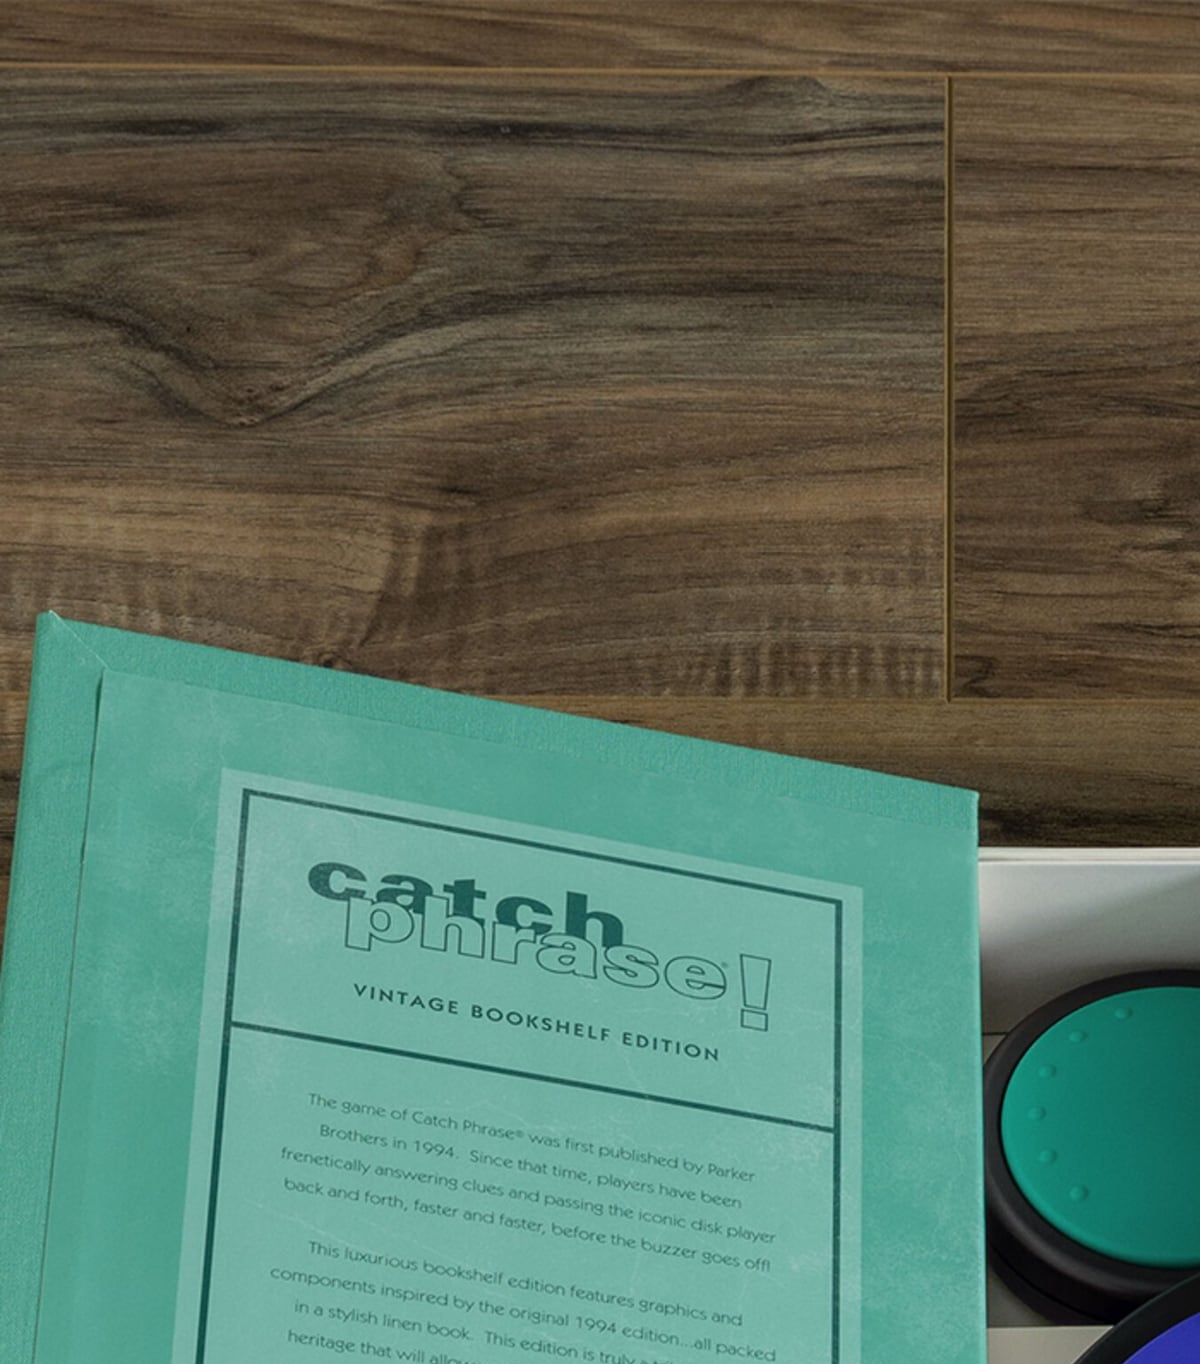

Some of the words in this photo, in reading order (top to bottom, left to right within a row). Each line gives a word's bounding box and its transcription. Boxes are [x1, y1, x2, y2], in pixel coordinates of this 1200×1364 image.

[308, 861, 625, 948] catch
[344, 894, 772, 1032] phrase!
[353, 982, 458, 1015] VINTAGE
[470, 1003, 610, 1041] BOOKSHELF
[621, 1031, 718, 1061] EDITION
[308, 1092, 337, 1110] The
[340, 1100, 386, 1117] game
[389, 1107, 408, 1121] of
[410, 1110, 458, 1130] Catch
[527, 1133, 561, 1148] was
[564, 1136, 594, 1155] first
[597, 1145, 679, 1169] published
[681, 1157, 704, 1175] by
[707, 1162, 755, 1182] Parker
[319, 1123, 388, 1147] Brothers
[391, 1135, 407, 1150] in
[468, 1148, 513, 1169] Since
[516, 1158, 548, 1175] that
[551, 1164, 592, 1185] time,
[596, 1173, 655, 1194] players
[658, 1182, 696, 1201] have
[699, 1189, 742, 1209] been
[280, 1146, 371, 1175] frenetically
[373, 1165, 458, 1191] answering
[461, 1178, 505, 1197] clues
[507, 1188, 540, 1203] and
[543, 1194, 604, 1216] passing
[607, 1203, 634, 1219] the
[637, 1207, 686, 1229] iconic
[689, 1218, 723, 1235] disk
[725, 1225, 776, 1243] player
[283, 1176, 324, 1196] back
[326, 1186, 360, 1201] and
[363, 1189, 408, 1212] forth,
[413, 1198, 459, 1217] faster
[461, 1209, 495, 1224] and
[498, 1212, 546, 1236] faster,
[550, 1221, 606, 1244] before
[609, 1232, 636, 1249] the
[640, 1237, 697, 1259] buzzer
[701, 1250, 740, 1268] goes
[269, 1267, 376, 1295] components
[379, 1283, 449, 1307] inspired
[452, 1294, 475, 1313] by
[477, 1299, 505, 1316] the
[507, 1306, 569, 1327] original
[575, 1315, 616, 1334] 1994
[714, 1342, 776, 1362] packed
[308, 1239, 340, 1259] This
[343, 1246, 418, 1271] luxurious
[422, 1259, 504, 1285] bookshelf
[506, 1276, 566, 1296] edition
[569, 1284, 635, 1308] features
[637, 1298, 707, 1320] graphics
[710, 1311, 743, 1327] and
[287, 1328, 356, 1353] heritage
[359, 1341, 392, 1359] that
[395, 1348, 425, 1363] will
[293, 1298, 309, 1314] in
[312, 1305, 324, 1317] a
[327, 1306, 378, 1325] stylish
[381, 1313, 422, 1332] linen
[484, 1329, 516, 1348] This
[518, 1339, 578, 1358] edition
[581, 1346, 595, 1362] is
